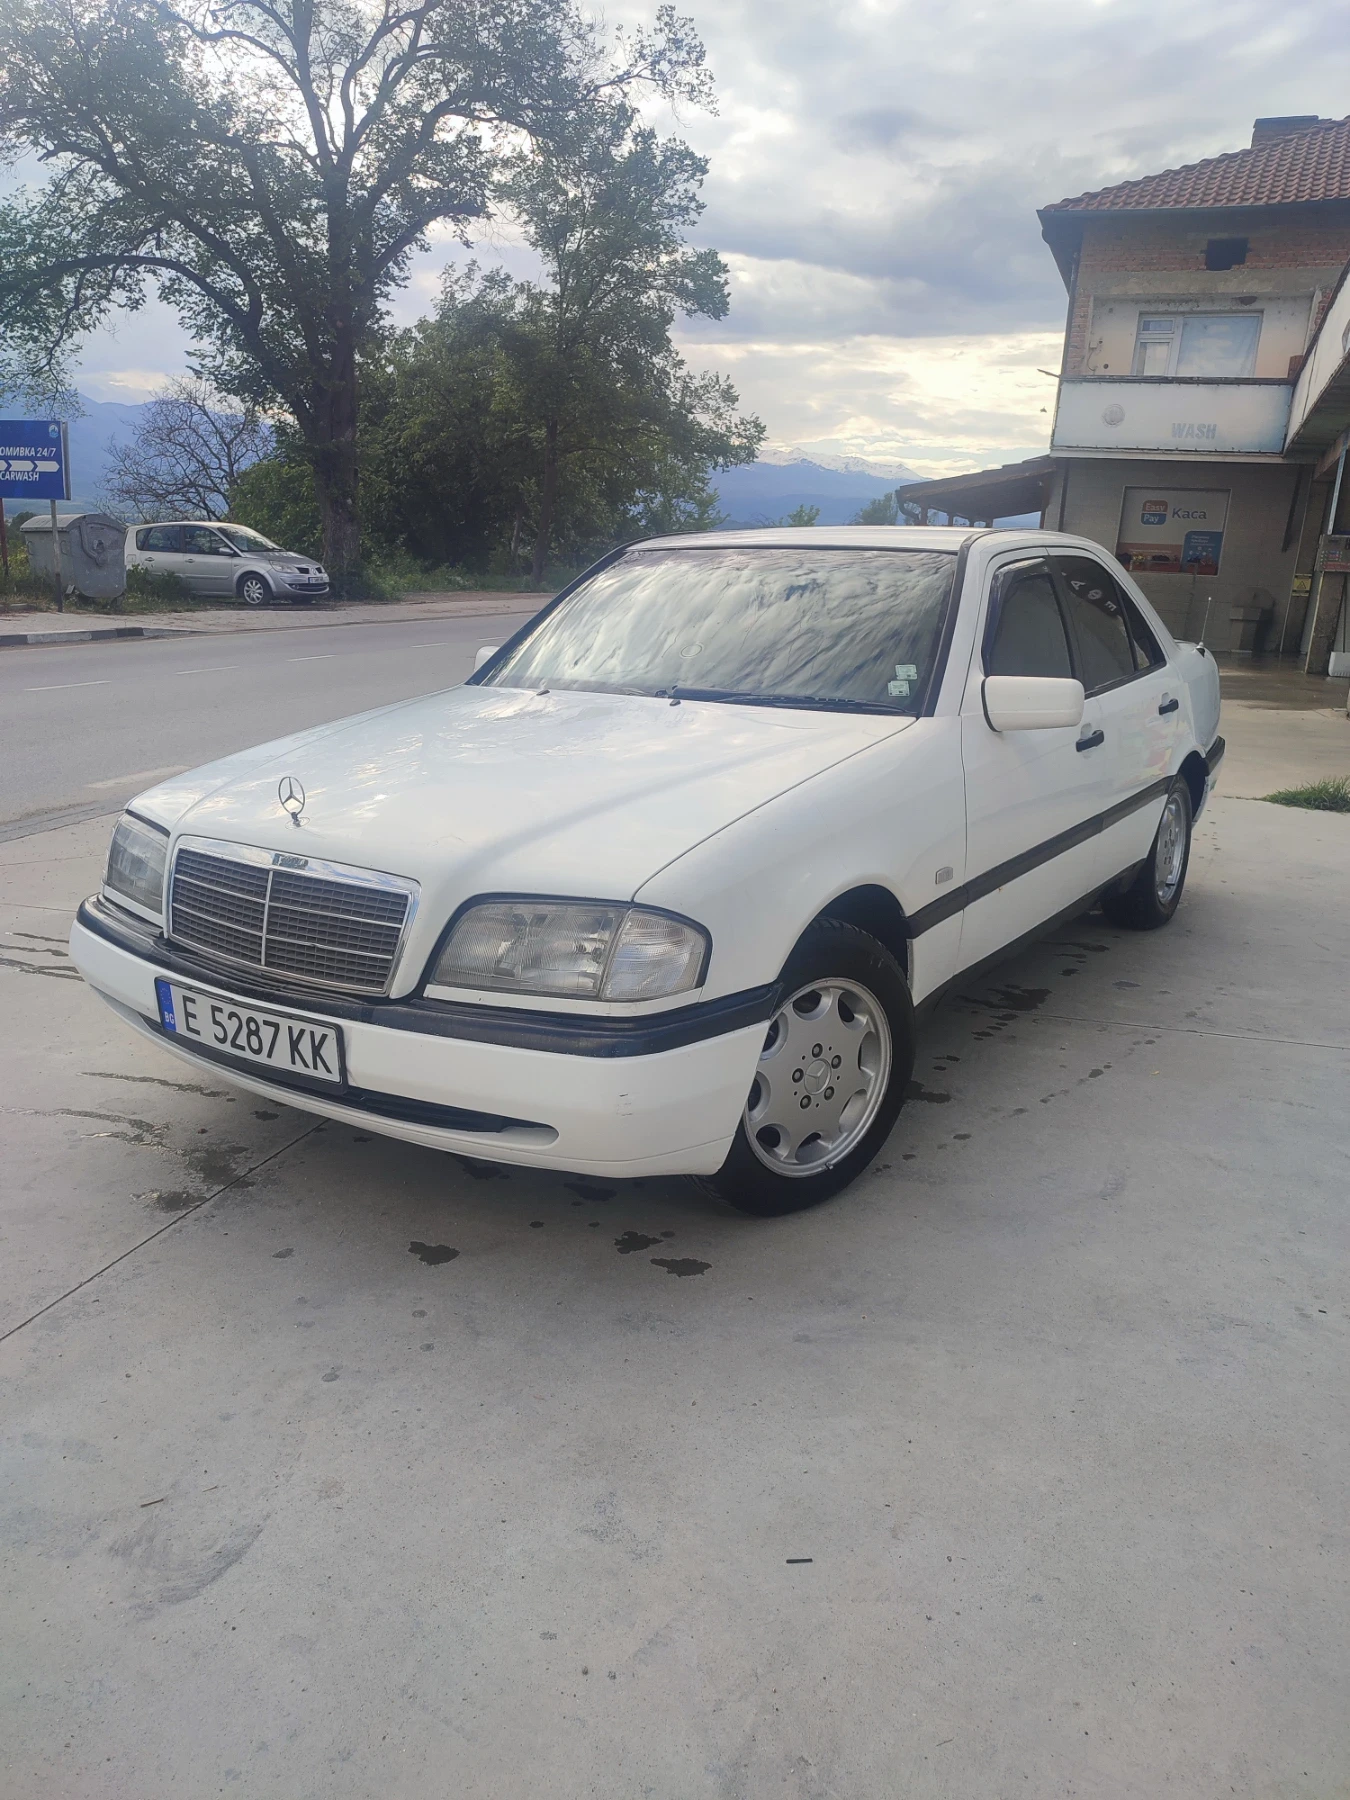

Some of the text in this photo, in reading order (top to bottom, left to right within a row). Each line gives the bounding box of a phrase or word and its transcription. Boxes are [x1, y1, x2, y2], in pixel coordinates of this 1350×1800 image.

[1171, 423, 1217, 440] WASH
[37, 448, 57, 457] 24/7
[0, 471, 39, 482] CARWASH
[1145, 503, 1166, 512] Easy
[1143, 513, 1160, 524] Pay
[1172, 508, 1207, 520] Каса
[164, 1011, 175, 1024] BG
[182, 994, 333, 1075] E 5287 KK
